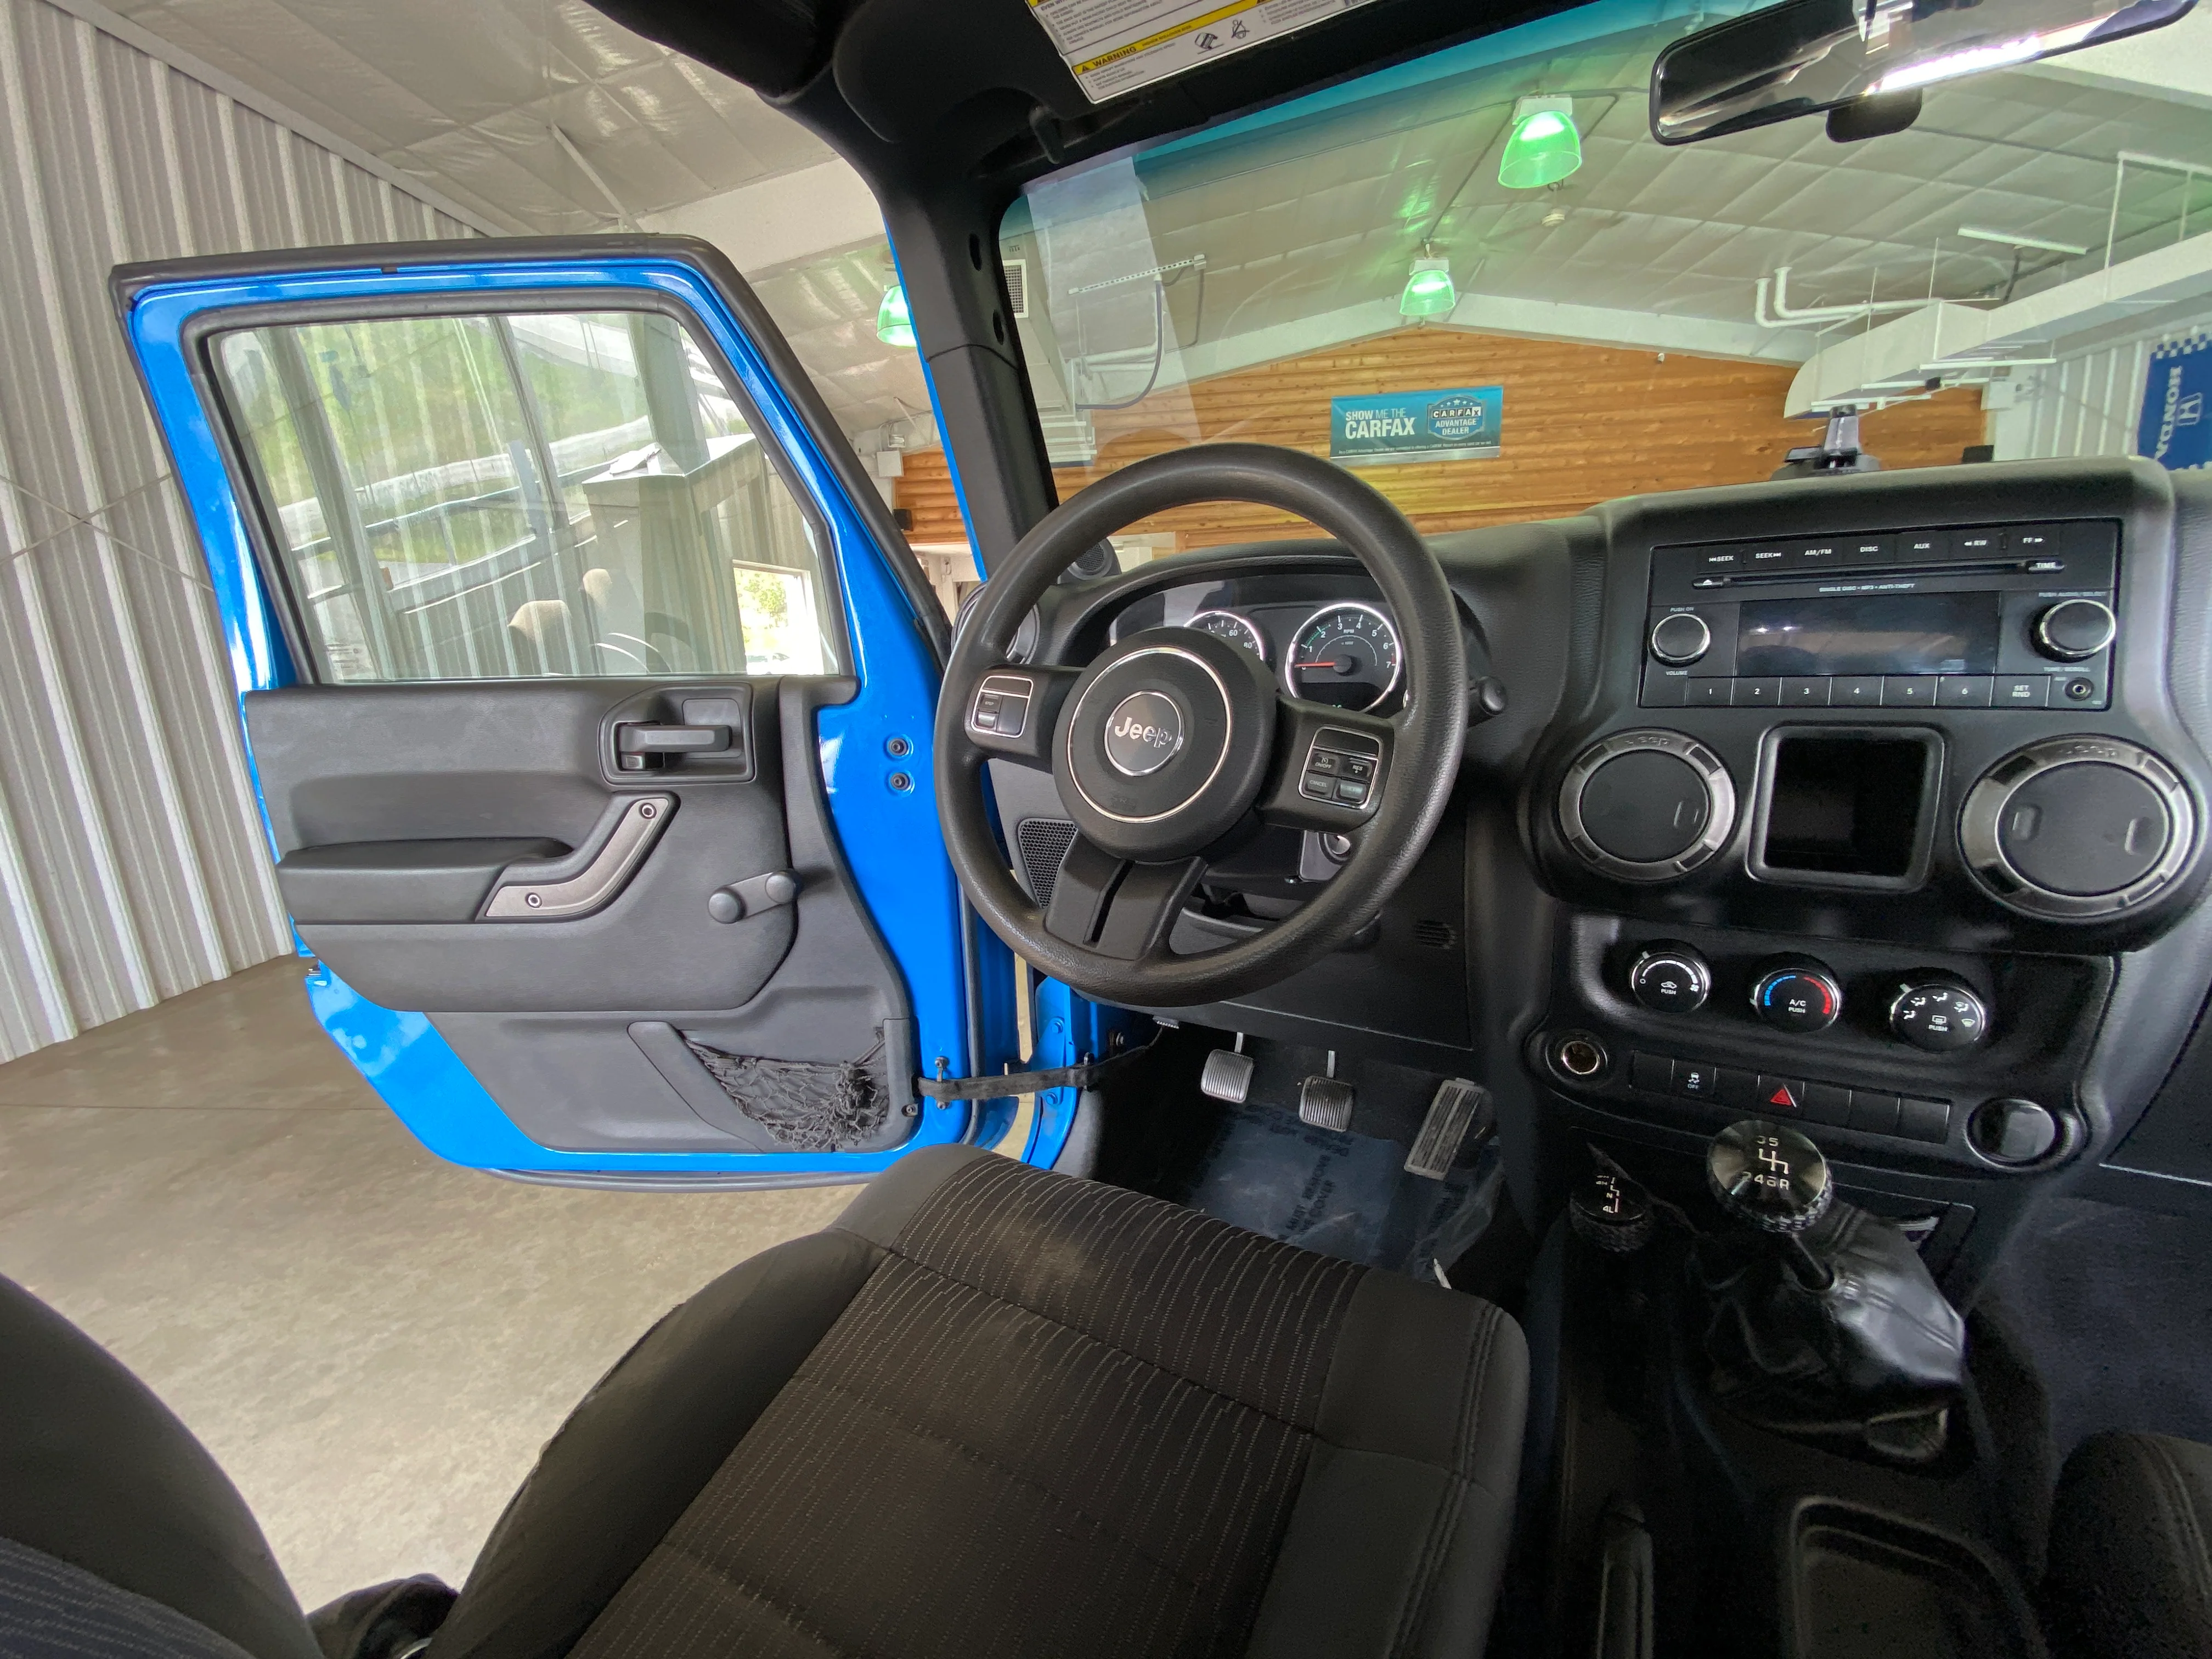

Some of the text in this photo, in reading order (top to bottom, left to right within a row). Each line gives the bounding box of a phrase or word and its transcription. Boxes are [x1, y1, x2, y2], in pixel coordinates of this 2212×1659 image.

[1092, 46, 1137, 67] WARNING
[1345, 408, 1407, 421] SHOW ME THE
[1432, 408, 1480, 418] CARFAX
[1345, 417, 1415, 439] CARFAX
[1435, 418, 1477, 428] ADVANTAGE
[1442, 426, 1470, 436] DEALER
[1114, 716, 1172, 748] Jeep
[1789, 998, 1807, 1007] A/C
[1769, 1137, 1779, 1147] 5
[1754, 1173, 1764, 1184] 4
[1779, 1178, 1790, 1190] R
[1602, 1205, 1615, 1214] 4L
